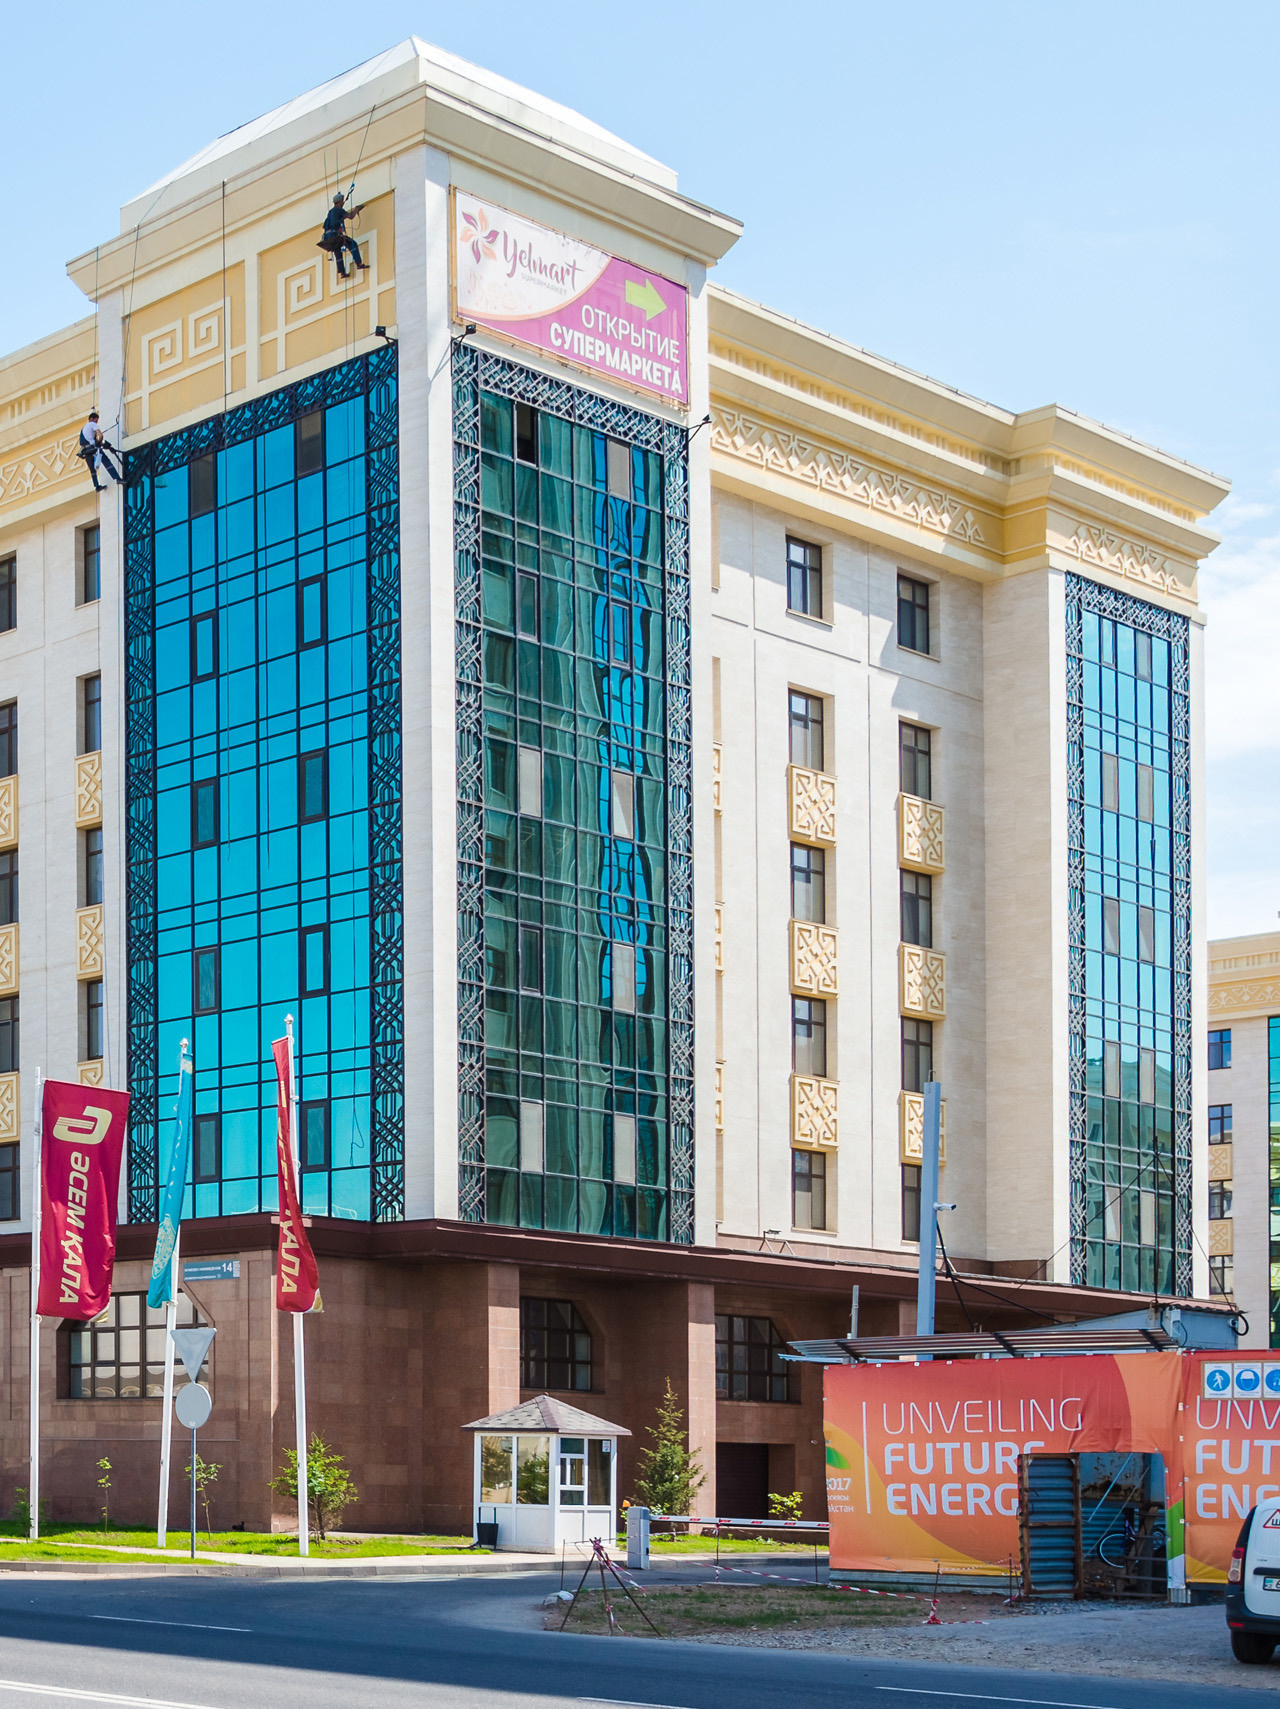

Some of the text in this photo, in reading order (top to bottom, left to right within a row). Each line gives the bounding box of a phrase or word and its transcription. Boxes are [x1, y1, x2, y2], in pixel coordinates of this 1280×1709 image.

[503, 230, 585, 292] Yelmart
[521, 272, 567, 297] SUPERMARKET
[550, 322, 683, 394] СУПЕРМАРКЕТА
[581, 304, 680, 364] ОТКРЫТИЕ
[222, 1262, 232, 1272] 14
[883, 1397, 1083, 1435] UNVEILING
